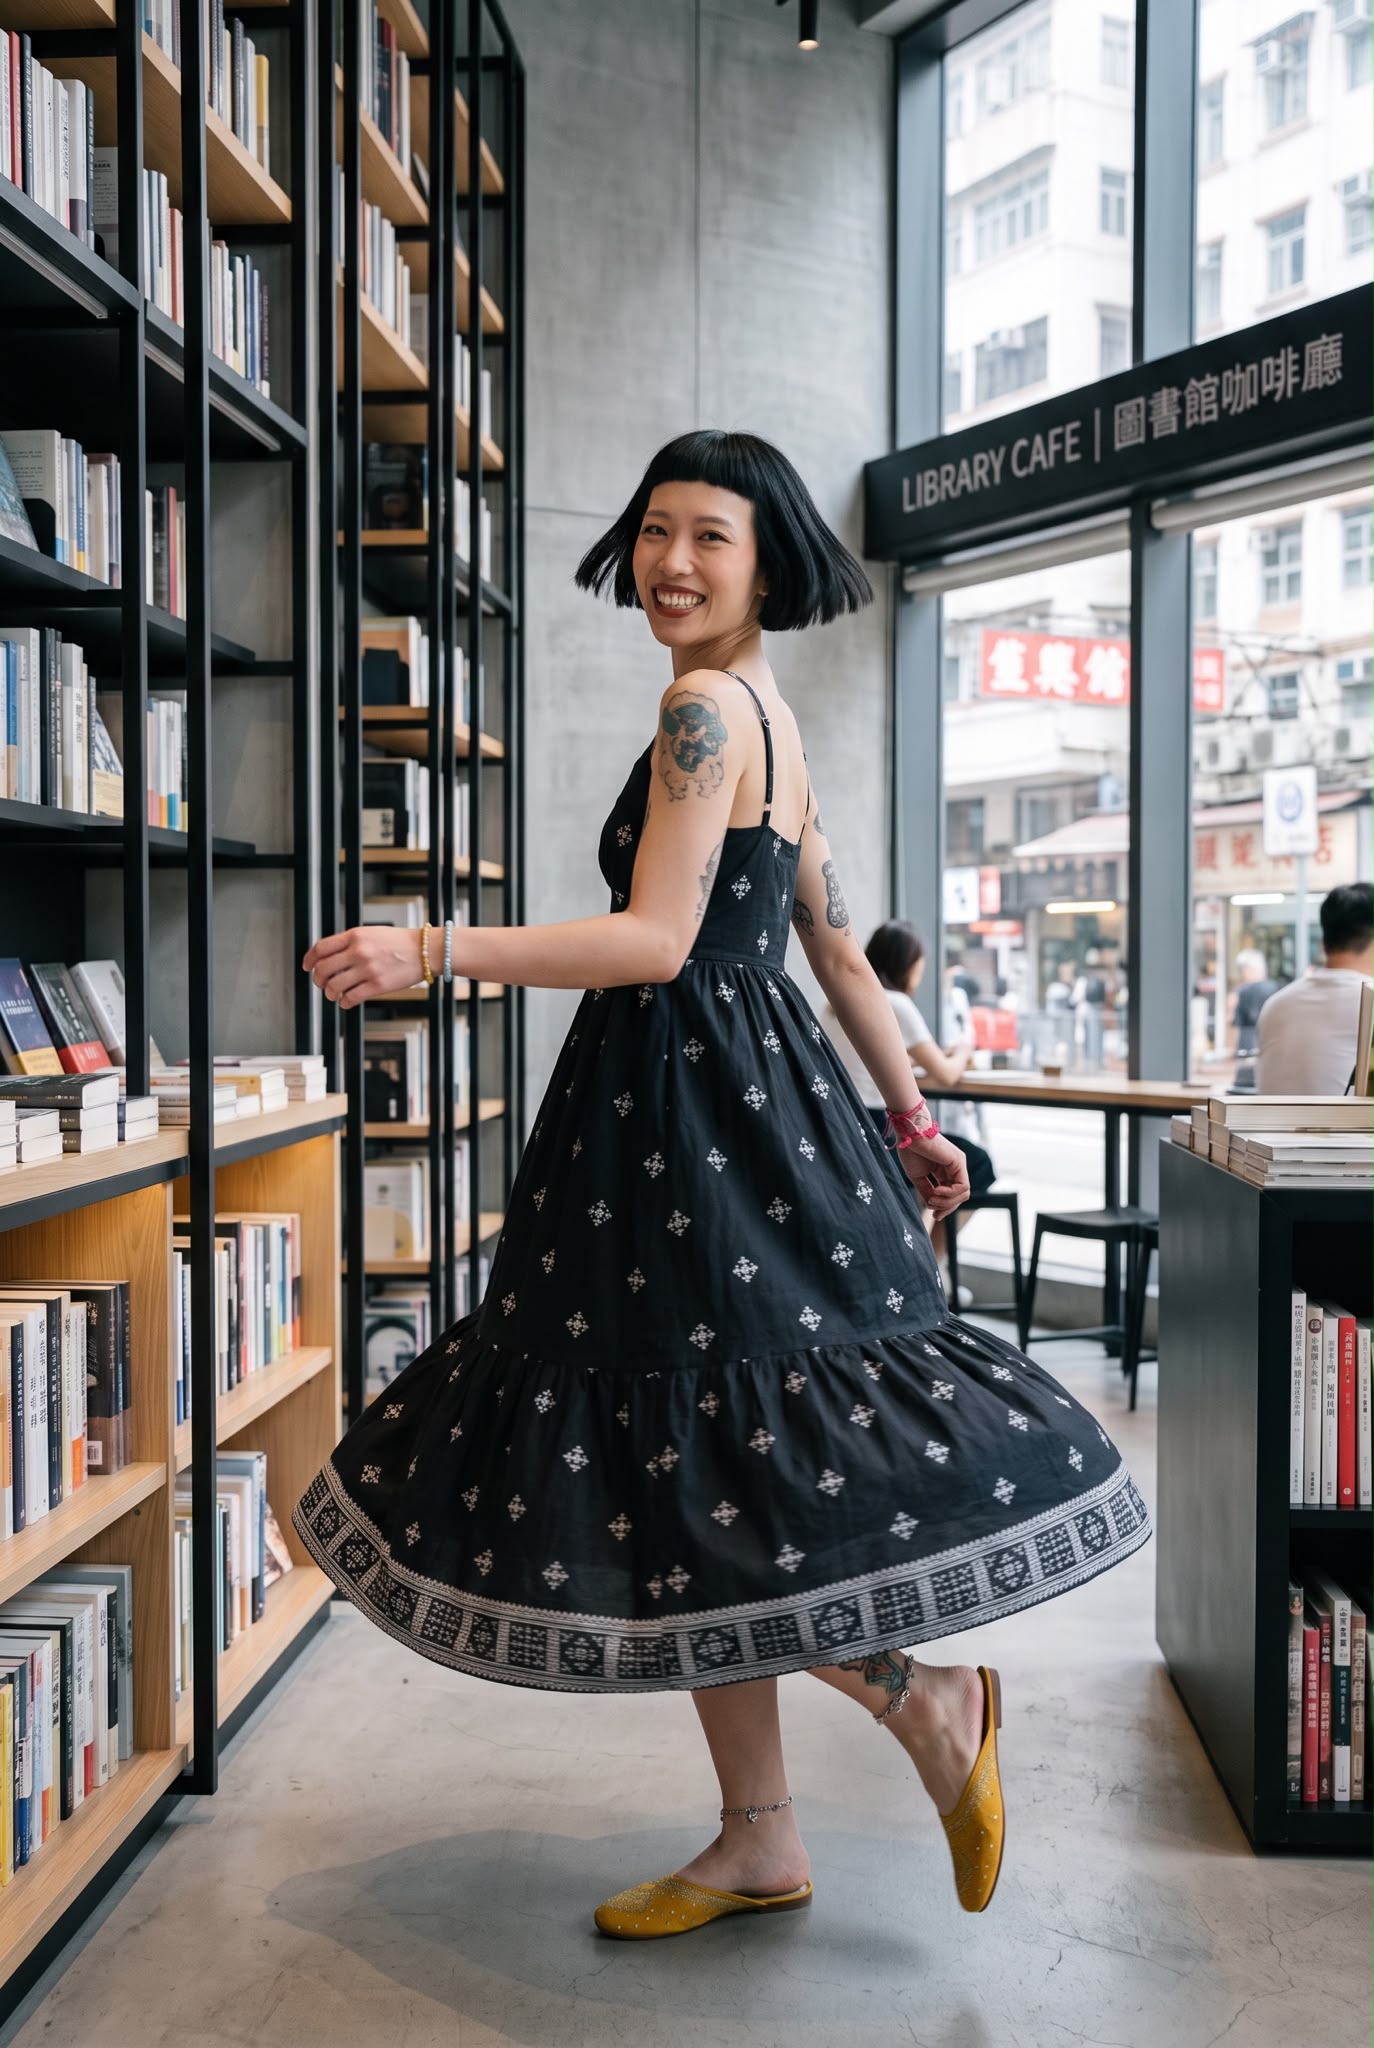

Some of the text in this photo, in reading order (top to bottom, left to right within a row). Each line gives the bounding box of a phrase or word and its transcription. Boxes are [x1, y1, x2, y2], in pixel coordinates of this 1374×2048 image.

[902, 333, 1343, 513] LIBRARY CAFE 圖書館咖啡廳
